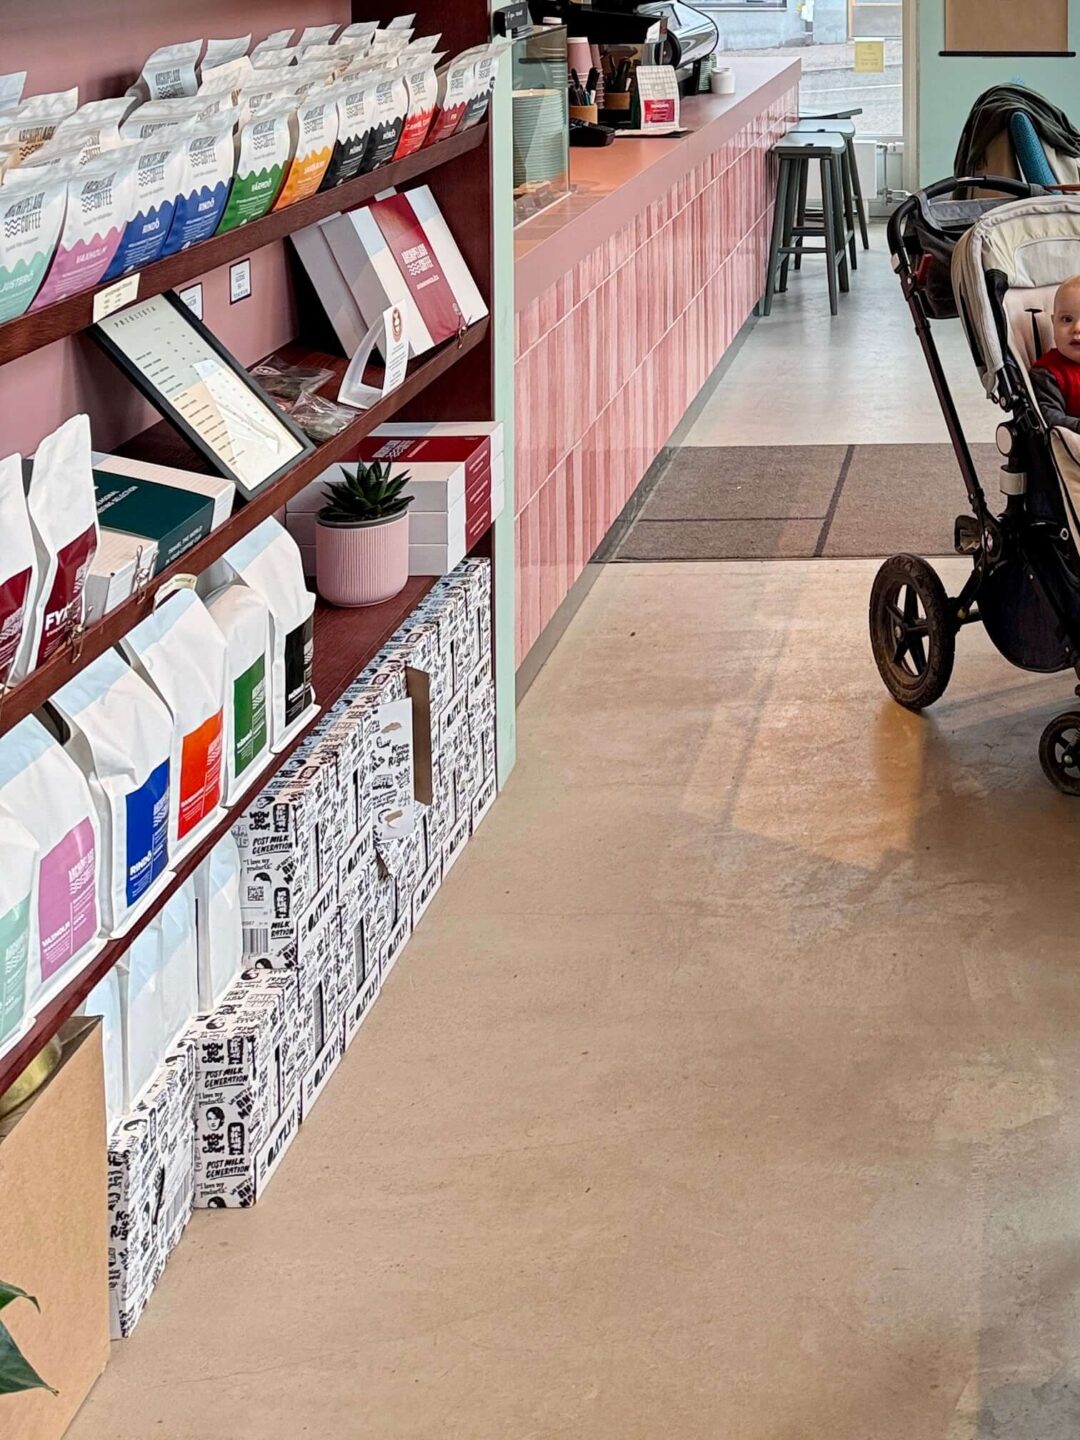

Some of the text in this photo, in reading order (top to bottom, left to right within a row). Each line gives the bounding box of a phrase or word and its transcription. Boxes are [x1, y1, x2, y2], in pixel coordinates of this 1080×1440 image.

[253, 835, 289, 846] POST MILK
[252, 843, 292, 854] GENERATION
[130, 850, 152, 875] RINDÖ
[308, 884, 334, 932] OATLY!
[271, 921, 290, 929] MILK
[356, 975, 378, 1021] OATLY!
[202, 1043, 223, 1051] WOW
[314, 1040, 339, 1087] OATLY!
[205, 1067, 243, 1079] POST MILK
[204, 1075, 248, 1088] GENERATION
[202, 1133, 224, 1141] WOW
[267, 1109, 295, 1167] OATLY!
[206, 1158, 244, 1170] POST MILK
[206, 1165, 249, 1178] GENERATION
